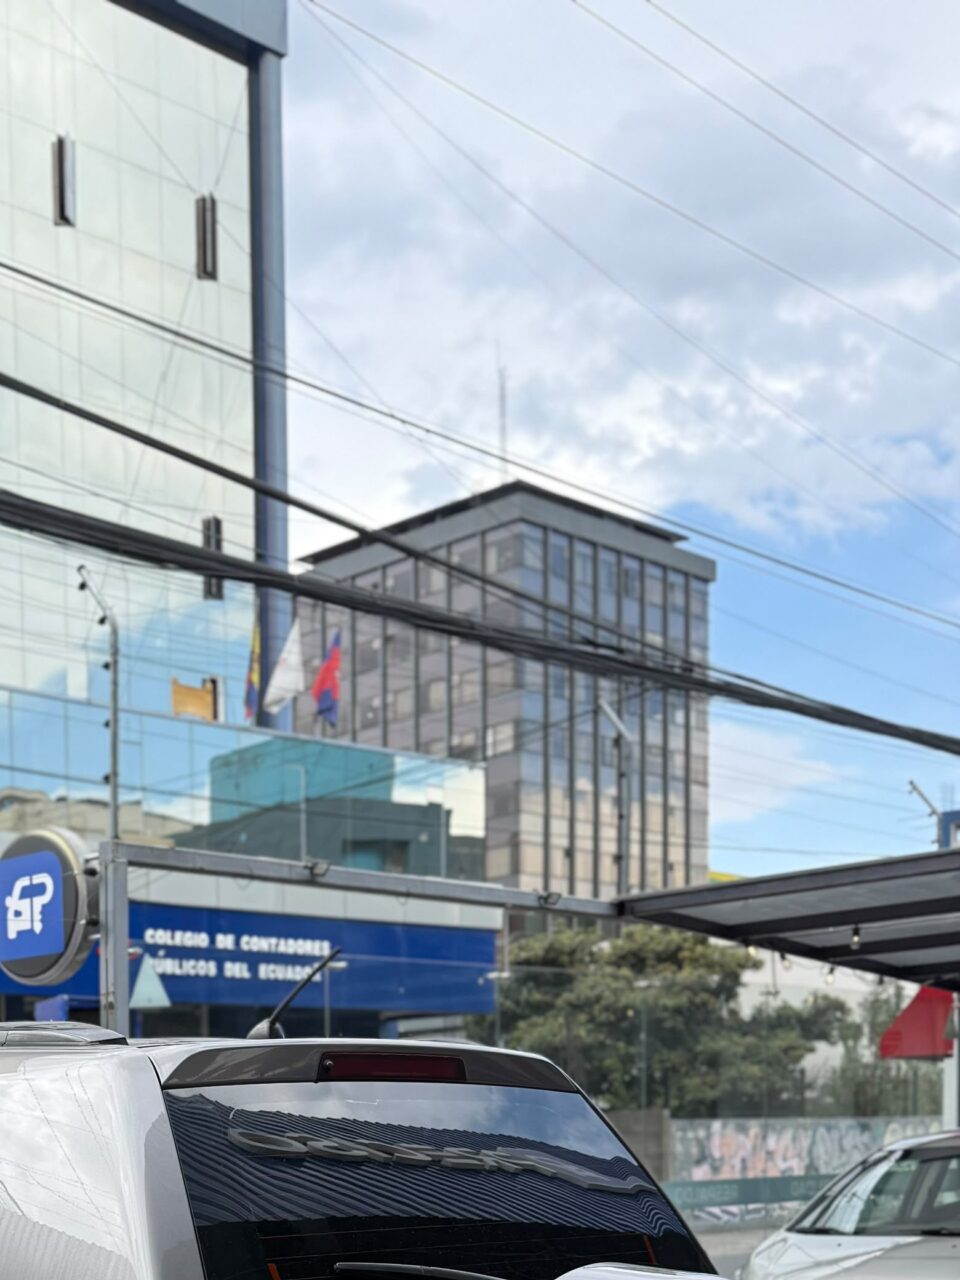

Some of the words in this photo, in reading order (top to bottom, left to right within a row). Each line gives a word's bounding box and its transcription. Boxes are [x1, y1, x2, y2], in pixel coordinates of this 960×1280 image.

[144, 928, 210, 948] COLEGIO
[215, 933, 236, 950] DE
[240, 935, 331, 956] CONTADORES
[224, 961, 251, 979] DEL
